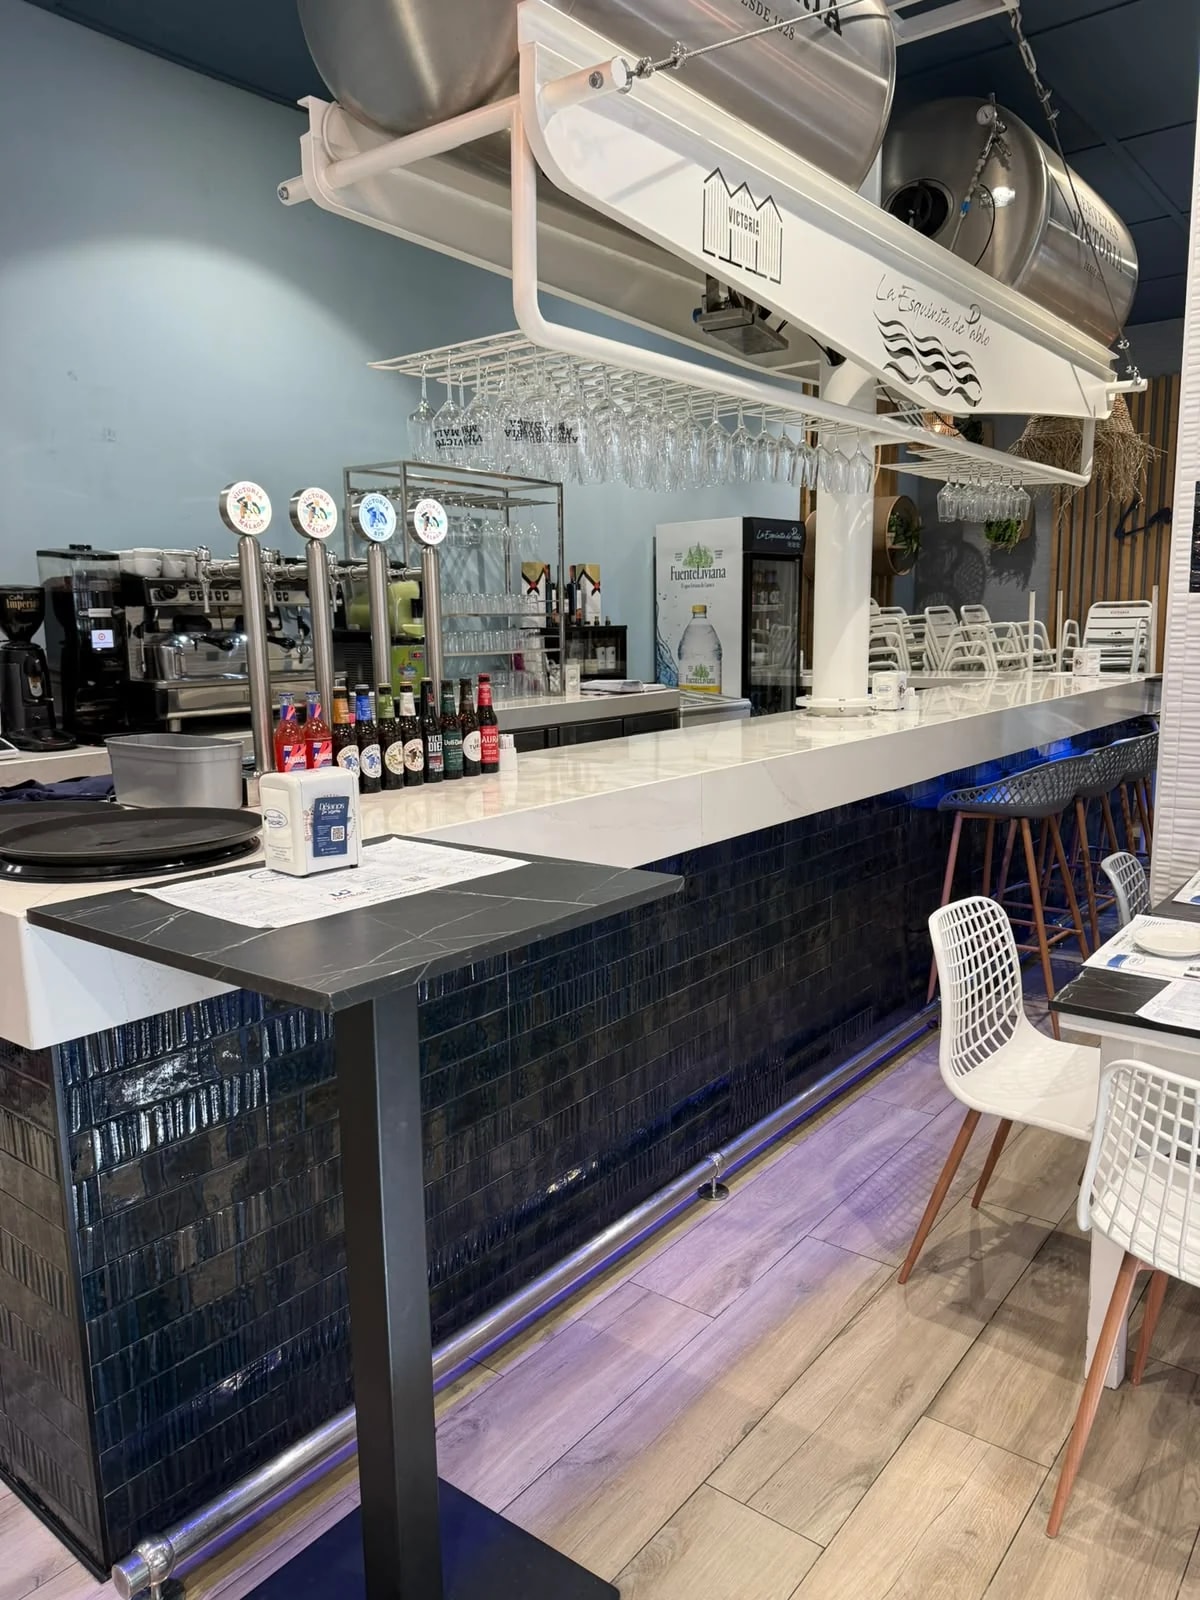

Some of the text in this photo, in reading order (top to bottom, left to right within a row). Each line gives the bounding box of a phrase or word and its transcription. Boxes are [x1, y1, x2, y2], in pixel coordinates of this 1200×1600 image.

[729, 206, 760, 236] VICTORIA
[1073, 210, 1122, 272] VICTORIA
[876, 274, 897, 301] La
[232, 486, 264, 500] VICTORIA
[302, 492, 331, 507] VICTORIA
[363, 497, 389, 512] VICTORIA
[670, 564, 726, 581] FuenteLiviana
[6, 598, 38, 611] Imperi
